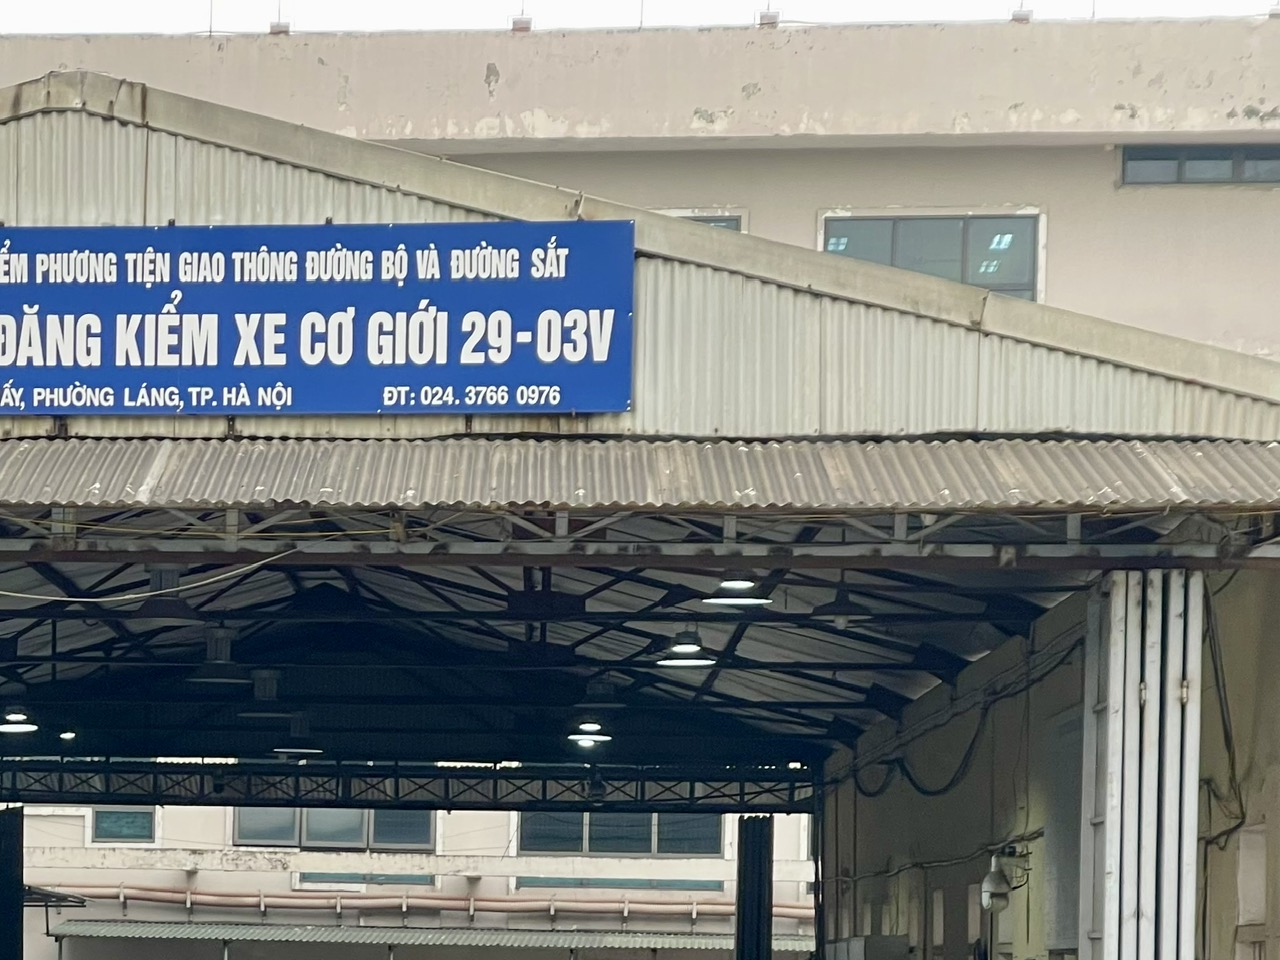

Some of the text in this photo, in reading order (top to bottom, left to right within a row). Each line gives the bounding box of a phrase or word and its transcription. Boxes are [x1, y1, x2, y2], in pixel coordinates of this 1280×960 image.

[35, 248, 117, 284] PHƯƠNG
[125, 246, 171, 289] TIỆN
[177, 249, 226, 282] GIAO
[232, 245, 298, 283] THÔNG
[305, 242, 373, 282] ĐƯỜNG
[381, 243, 409, 288] BỘ
[416, 242, 441, 280] VÀ
[450, 241, 520, 280] ĐƯỜNG
[531, 235, 570, 279] SẮT
[116, 290, 218, 366] KIỂM
[233, 313, 287, 366] XE
[300, 306, 355, 366] CƠ
[367, 299, 449, 366] GIỚI
[460, 308, 616, 365] 29-03V
[33, 381, 115, 408] PHƯỜNG
[124, 382, 185, 412] LÁNG,
[188, 387, 218, 407] TP.
[223, 382, 252, 407] HÀ
[258, 382, 293, 411] NỘI
[382, 384, 561, 406] ĐT: 024. 3766 0976
